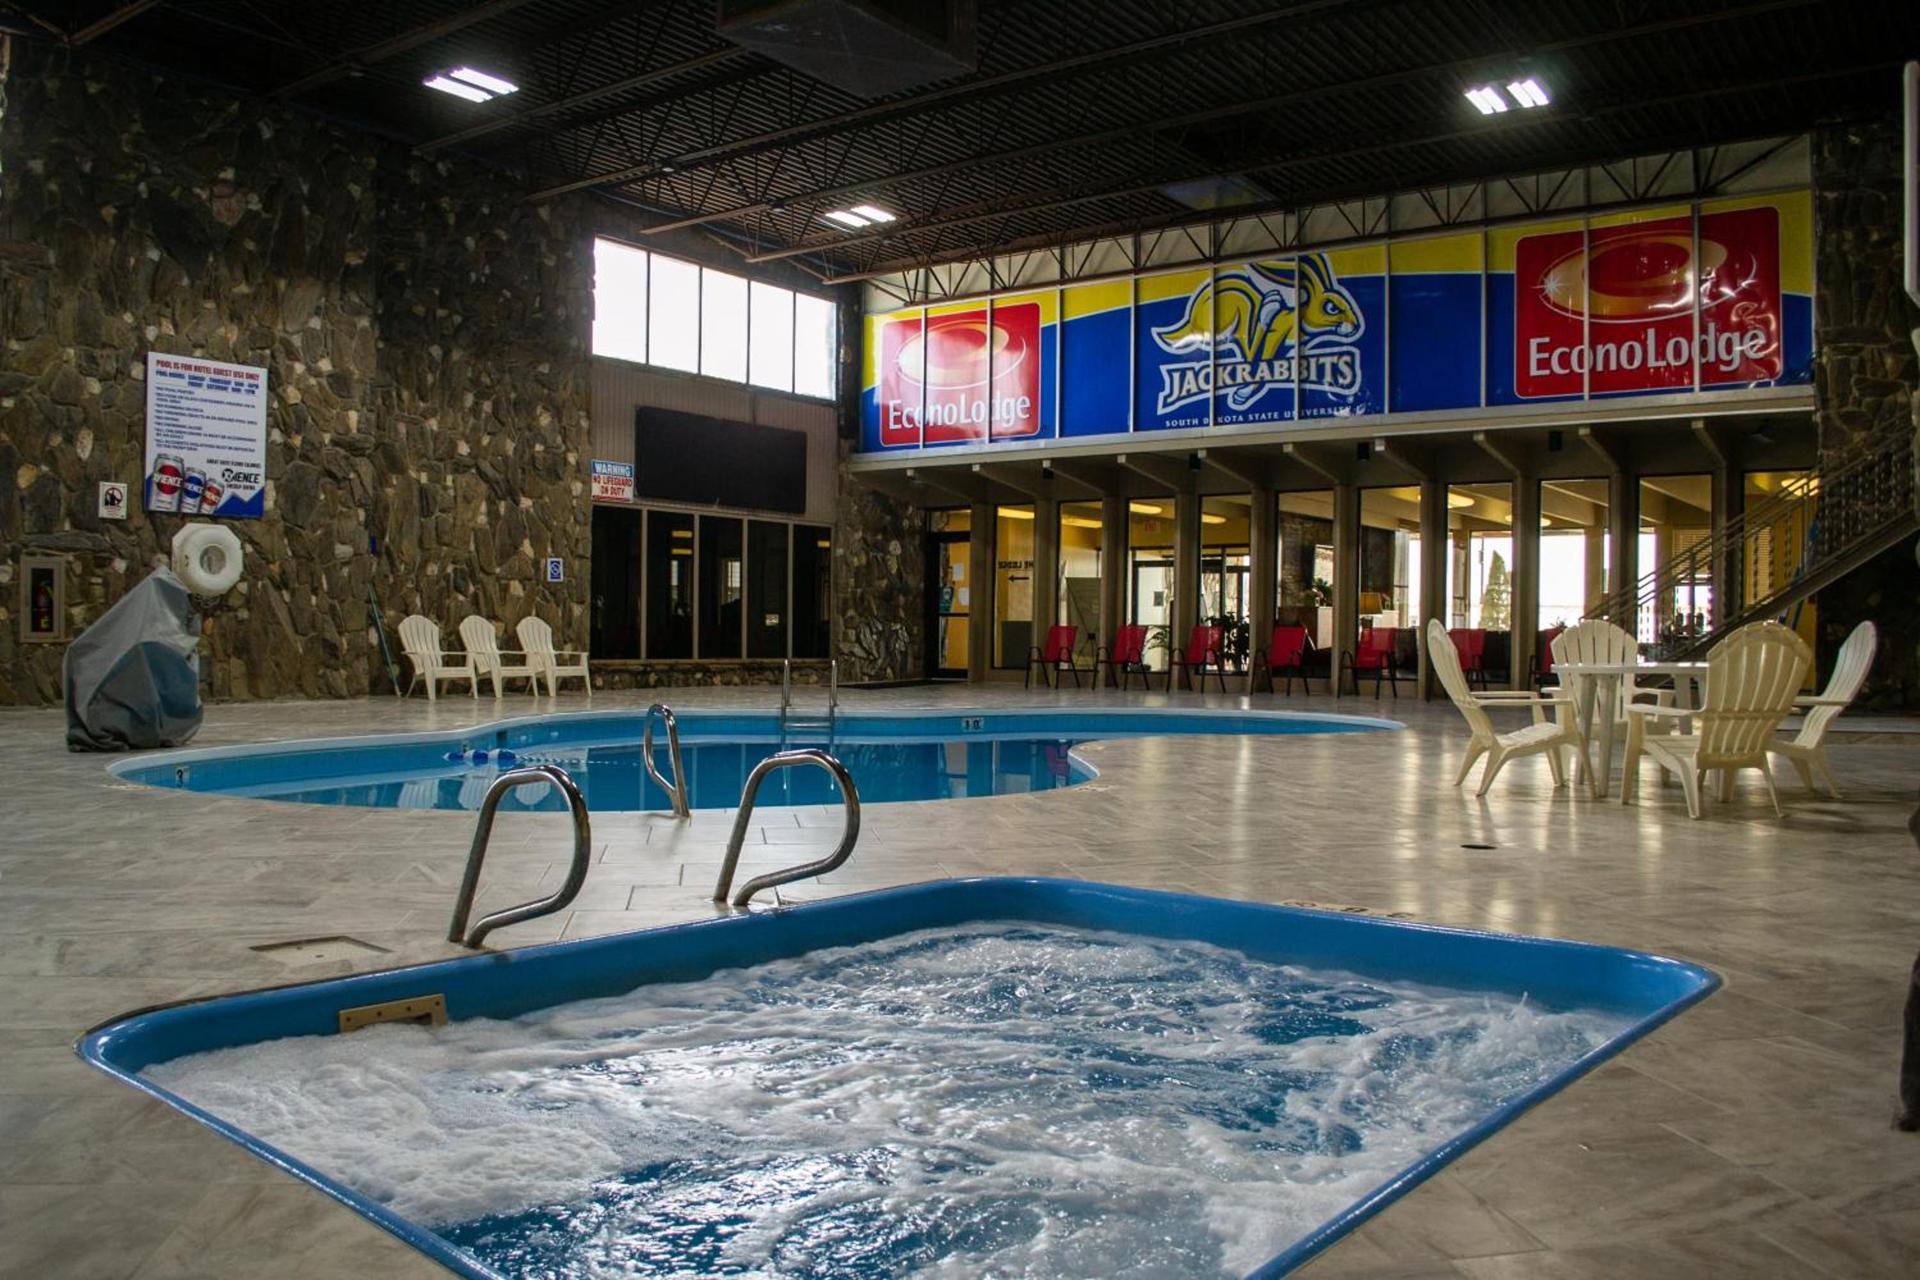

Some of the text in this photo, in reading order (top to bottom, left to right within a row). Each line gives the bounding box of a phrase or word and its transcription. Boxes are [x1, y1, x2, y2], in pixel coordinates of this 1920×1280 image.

[1529, 322, 1766, 377] EconoLodge
[1167, 354, 1354, 403] JACKRABBITS
[1165, 418, 1199, 428] SOUTH
[1203, 415, 1244, 425] DKOTA
[1248, 411, 1280, 421] STATE
[594, 462, 631, 477] WARNING
[592, 475, 633, 487] NO LIFEGUARD
[601, 485, 626, 496] ON DUTY
